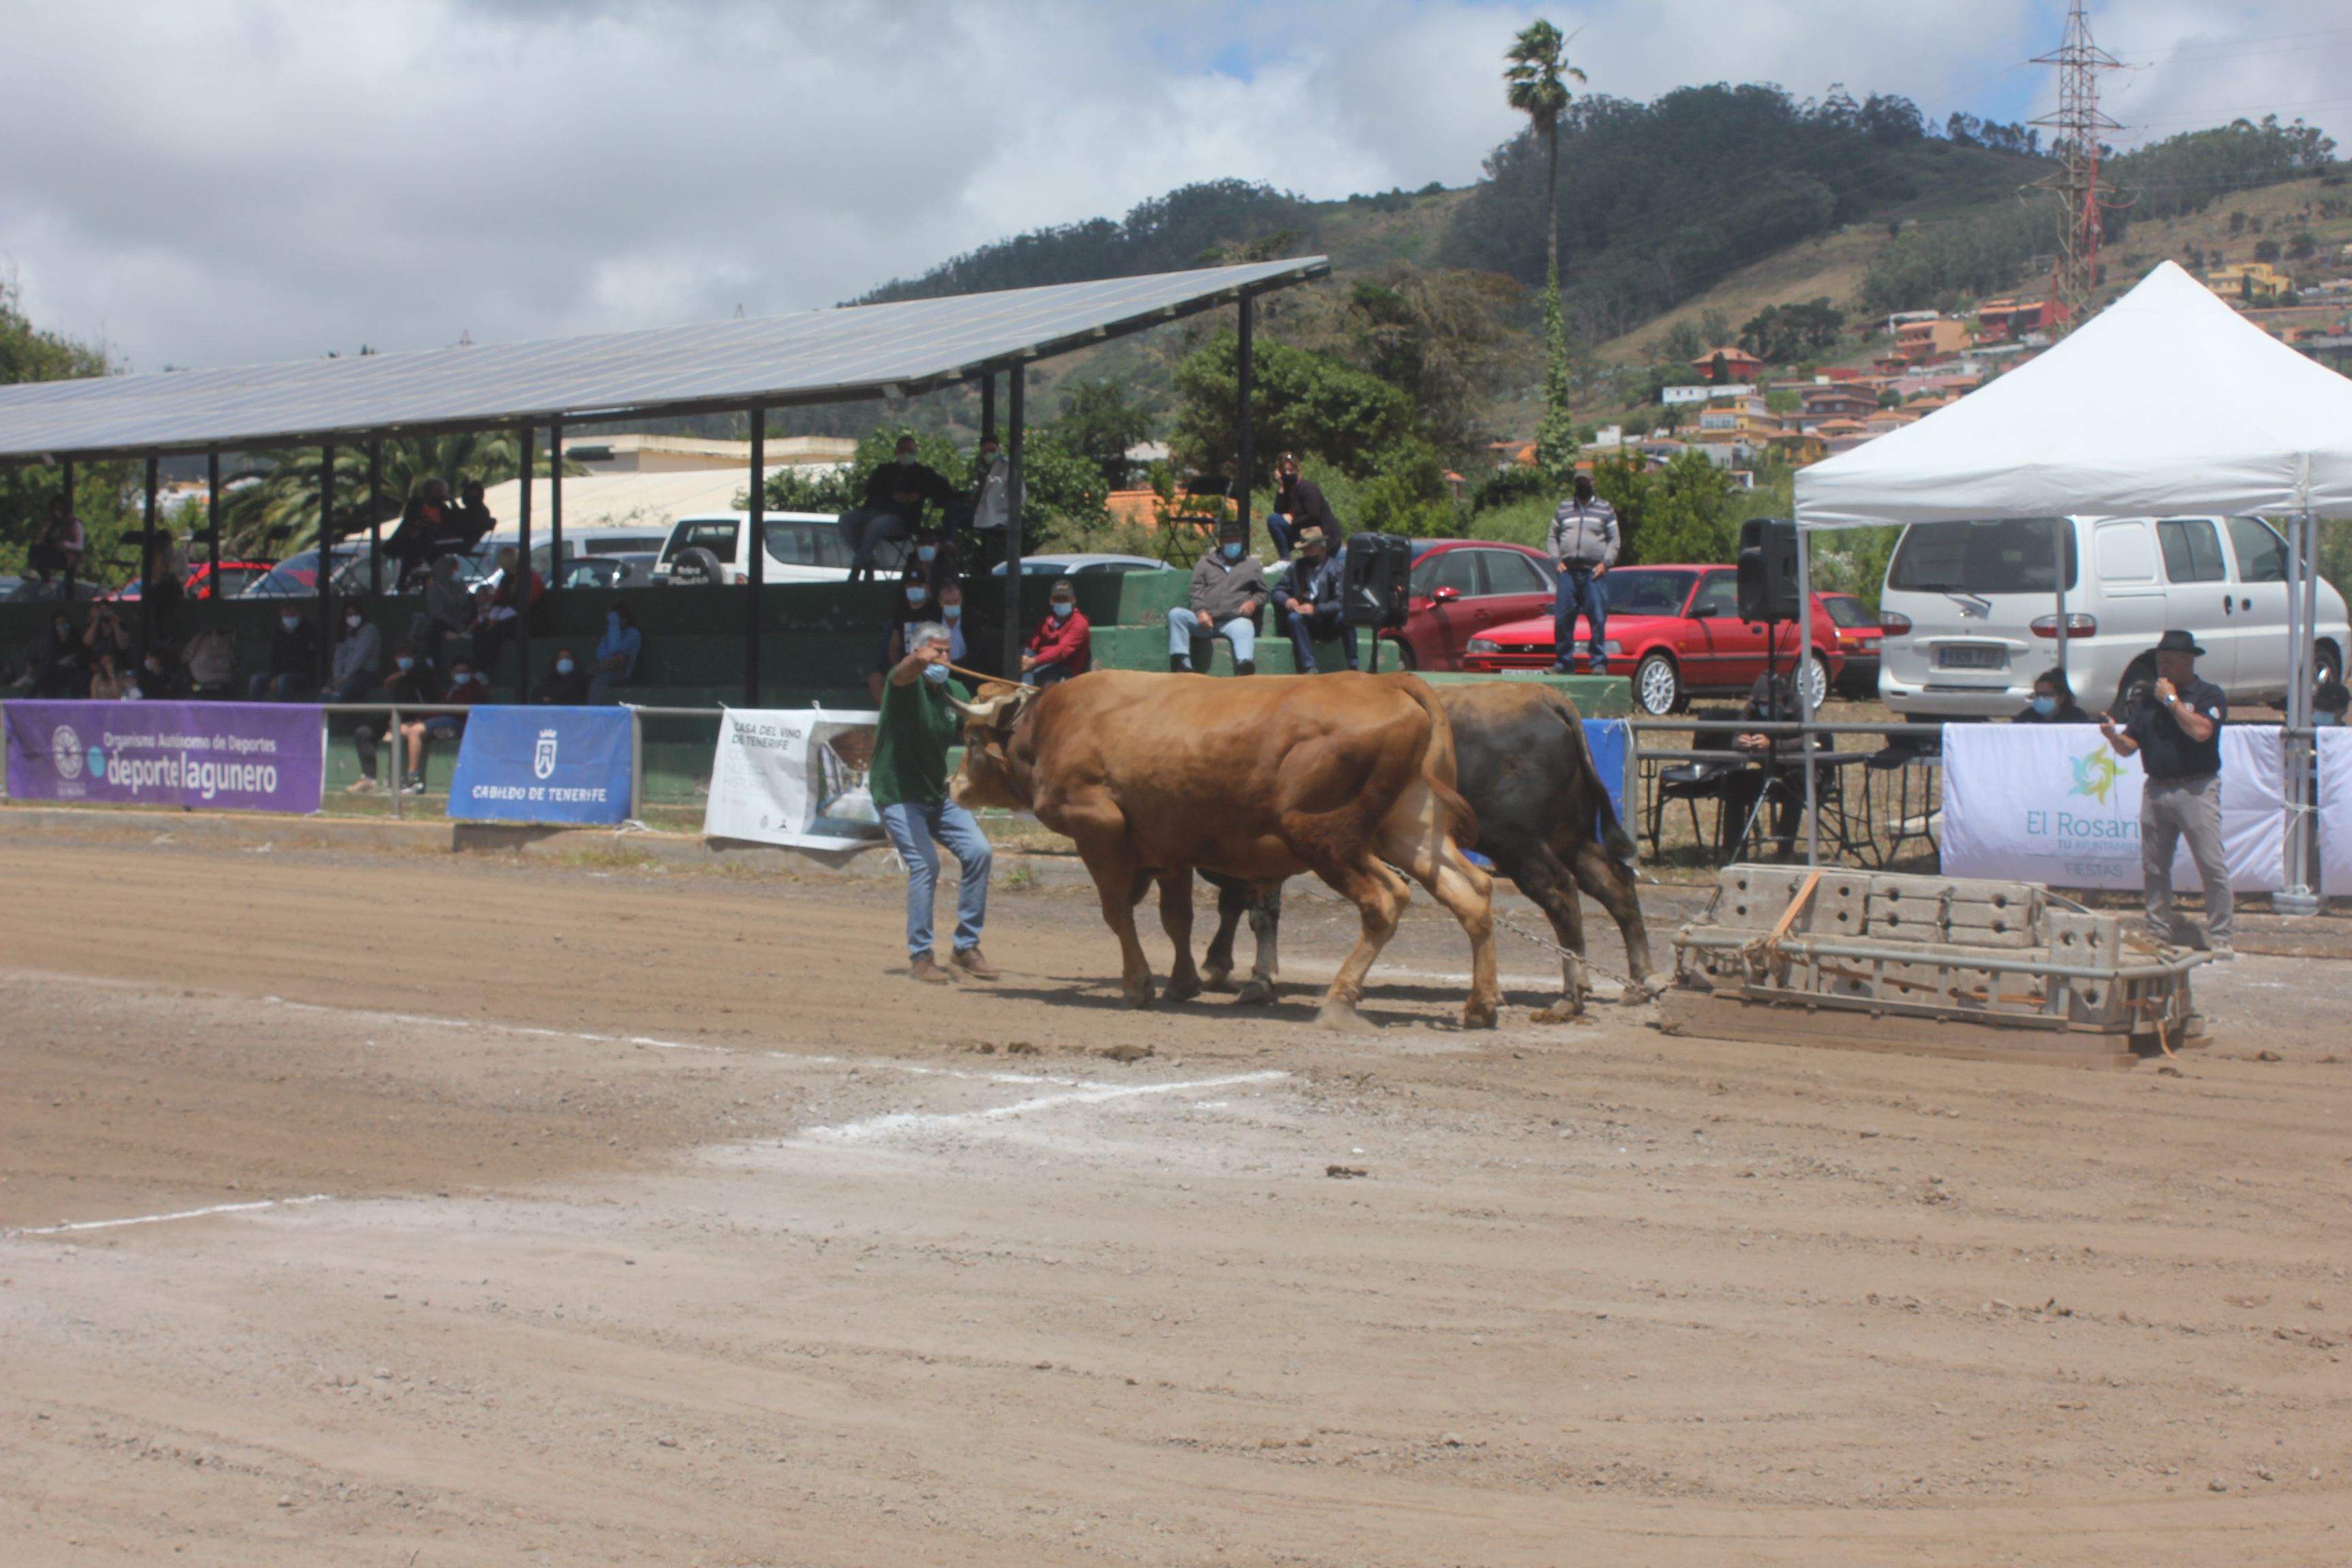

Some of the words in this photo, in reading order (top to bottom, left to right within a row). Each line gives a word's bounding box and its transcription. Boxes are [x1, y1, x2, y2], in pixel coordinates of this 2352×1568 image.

[760, 725, 776, 736] DEL
[780, 728, 801, 739] VINO
[103, 732, 155, 751] Organismo
[212, 734, 227, 750] de
[228, 734, 276, 755] Deportes
[747, 735, 789, 750] TENERIFE
[472, 785, 526, 800] CABILDO
[528, 787, 545, 801] DE
[549, 788, 607, 802] TENERIFE
[2027, 811, 2048, 835] El
[2057, 811, 2141, 838] Rosari
[2057, 838, 2072, 850] TU
[2074, 840, 2142, 853] AYUNTAMIEN
[2064, 862, 2123, 879] FIESTAS
